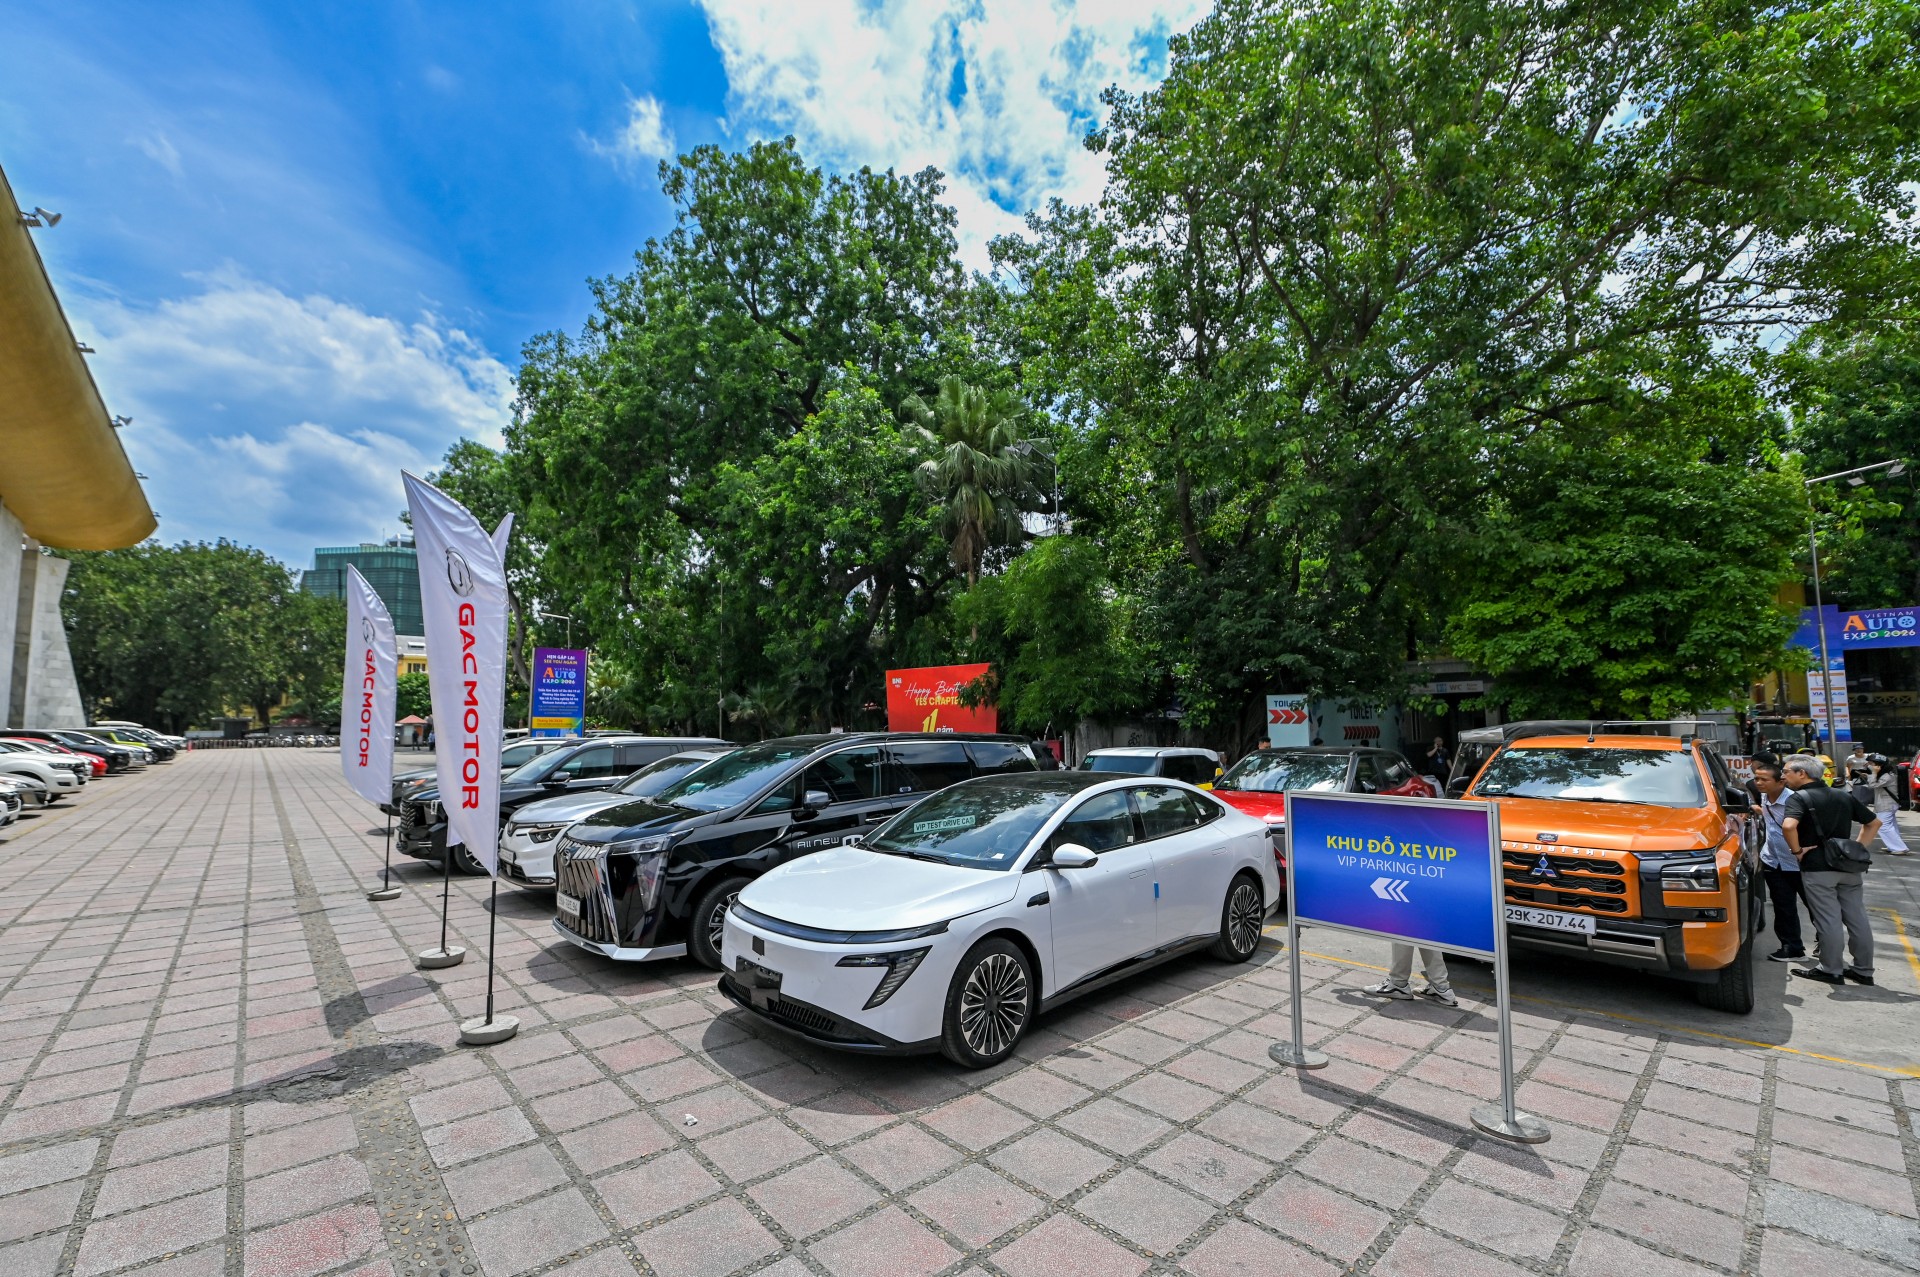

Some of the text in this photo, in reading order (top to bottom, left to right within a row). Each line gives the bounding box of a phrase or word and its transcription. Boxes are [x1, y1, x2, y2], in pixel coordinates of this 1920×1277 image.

[1843, 614, 1916, 632] AUTO
[1843, 629, 1916, 640] EXPO 2026
[904, 682, 931, 700] Happy
[359, 649, 376, 767] GAC MOTOR
[459, 603, 479, 809] GAC MOTOR
[915, 696, 927, 706] YES
[915, 823, 926, 831] VIP
[928, 821, 941, 829] TEST
[943, 819, 960, 827] DRIVE
[1326, 835, 1457, 862] KHU ĐỖ XE VIP
[1502, 842, 1606, 857] ITSUBISHI
[1337, 855, 1446, 879] VIP PARKING LOT
[1505, 908, 1587, 930] 29K-207.44
